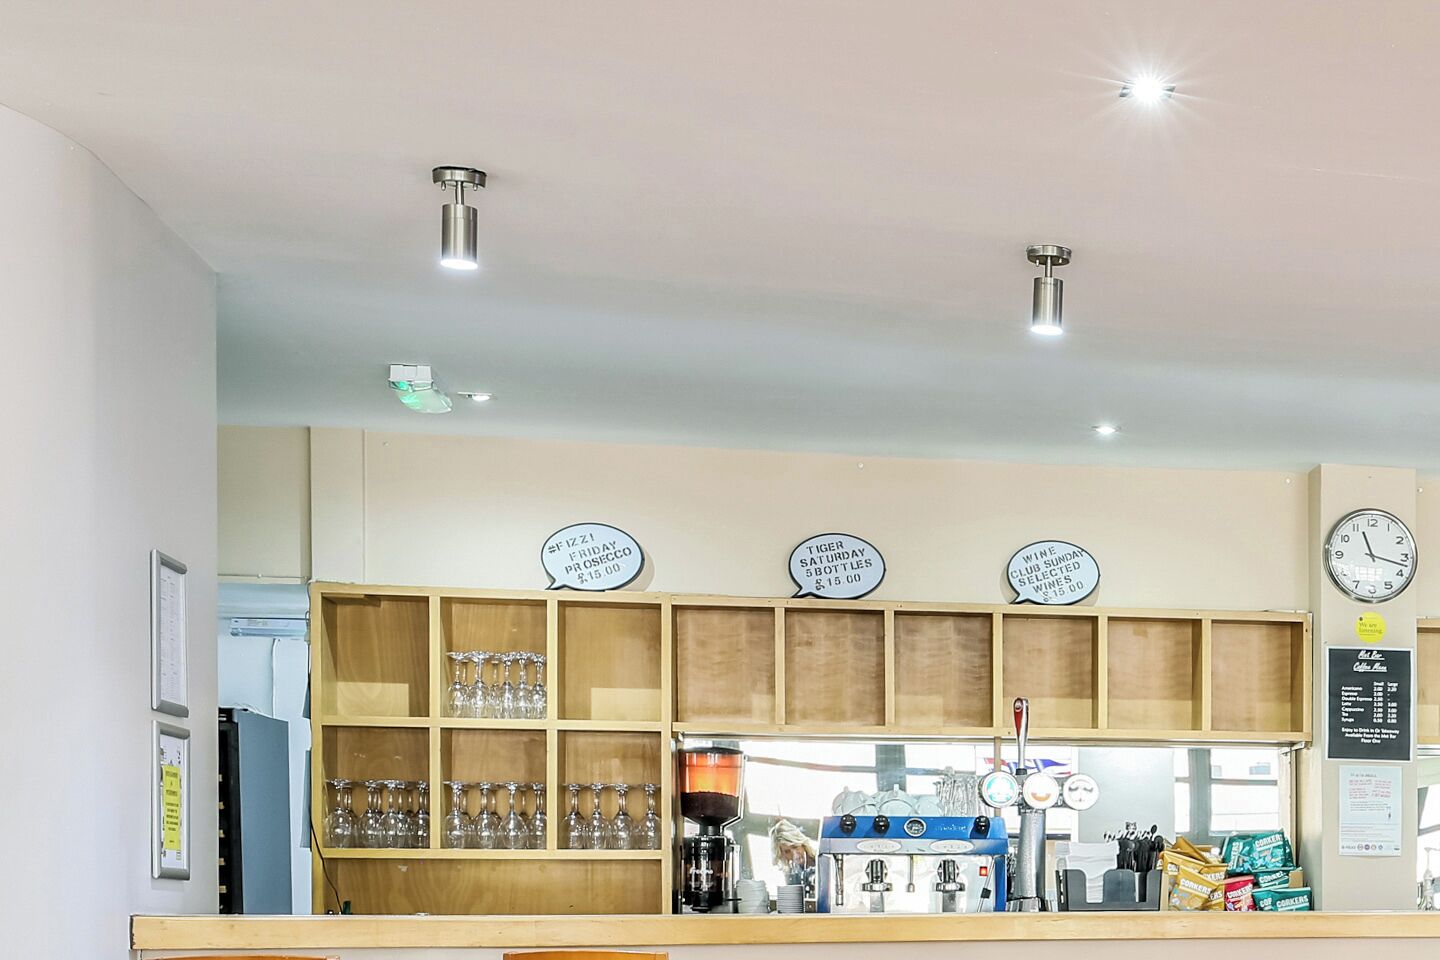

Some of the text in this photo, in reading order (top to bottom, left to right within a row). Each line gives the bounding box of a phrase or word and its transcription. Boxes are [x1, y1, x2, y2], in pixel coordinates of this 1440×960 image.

[1353, 524, 1359, 532] 11
[1368, 519, 1378, 527] 12
[1388, 523, 1389, 531] 1
[1341, 535, 1350, 543] 10
[569, 541, 616, 561] FRIDAY
[807, 541, 844, 554] TIGER
[565, 547, 632, 574] PROSECCO
[800, 548, 865, 567] SATURDAY
[1023, 546, 1056, 564] WINE
[1335, 551, 1343, 559] 9
[1401, 553, 1409, 562] 3
[815, 558, 872, 576] BOTTLES
[1011, 549, 1085, 579] CLUB SUNDAY
[1019, 561, 1080, 587] SELECTED
[1396, 569, 1403, 577] 4
[1033, 575, 1072, 593] WINES
[1353, 580, 1360, 589] 7
[1384, 581, 1393, 589] 5
[1276, 895, 1308, 907] CORKERS
